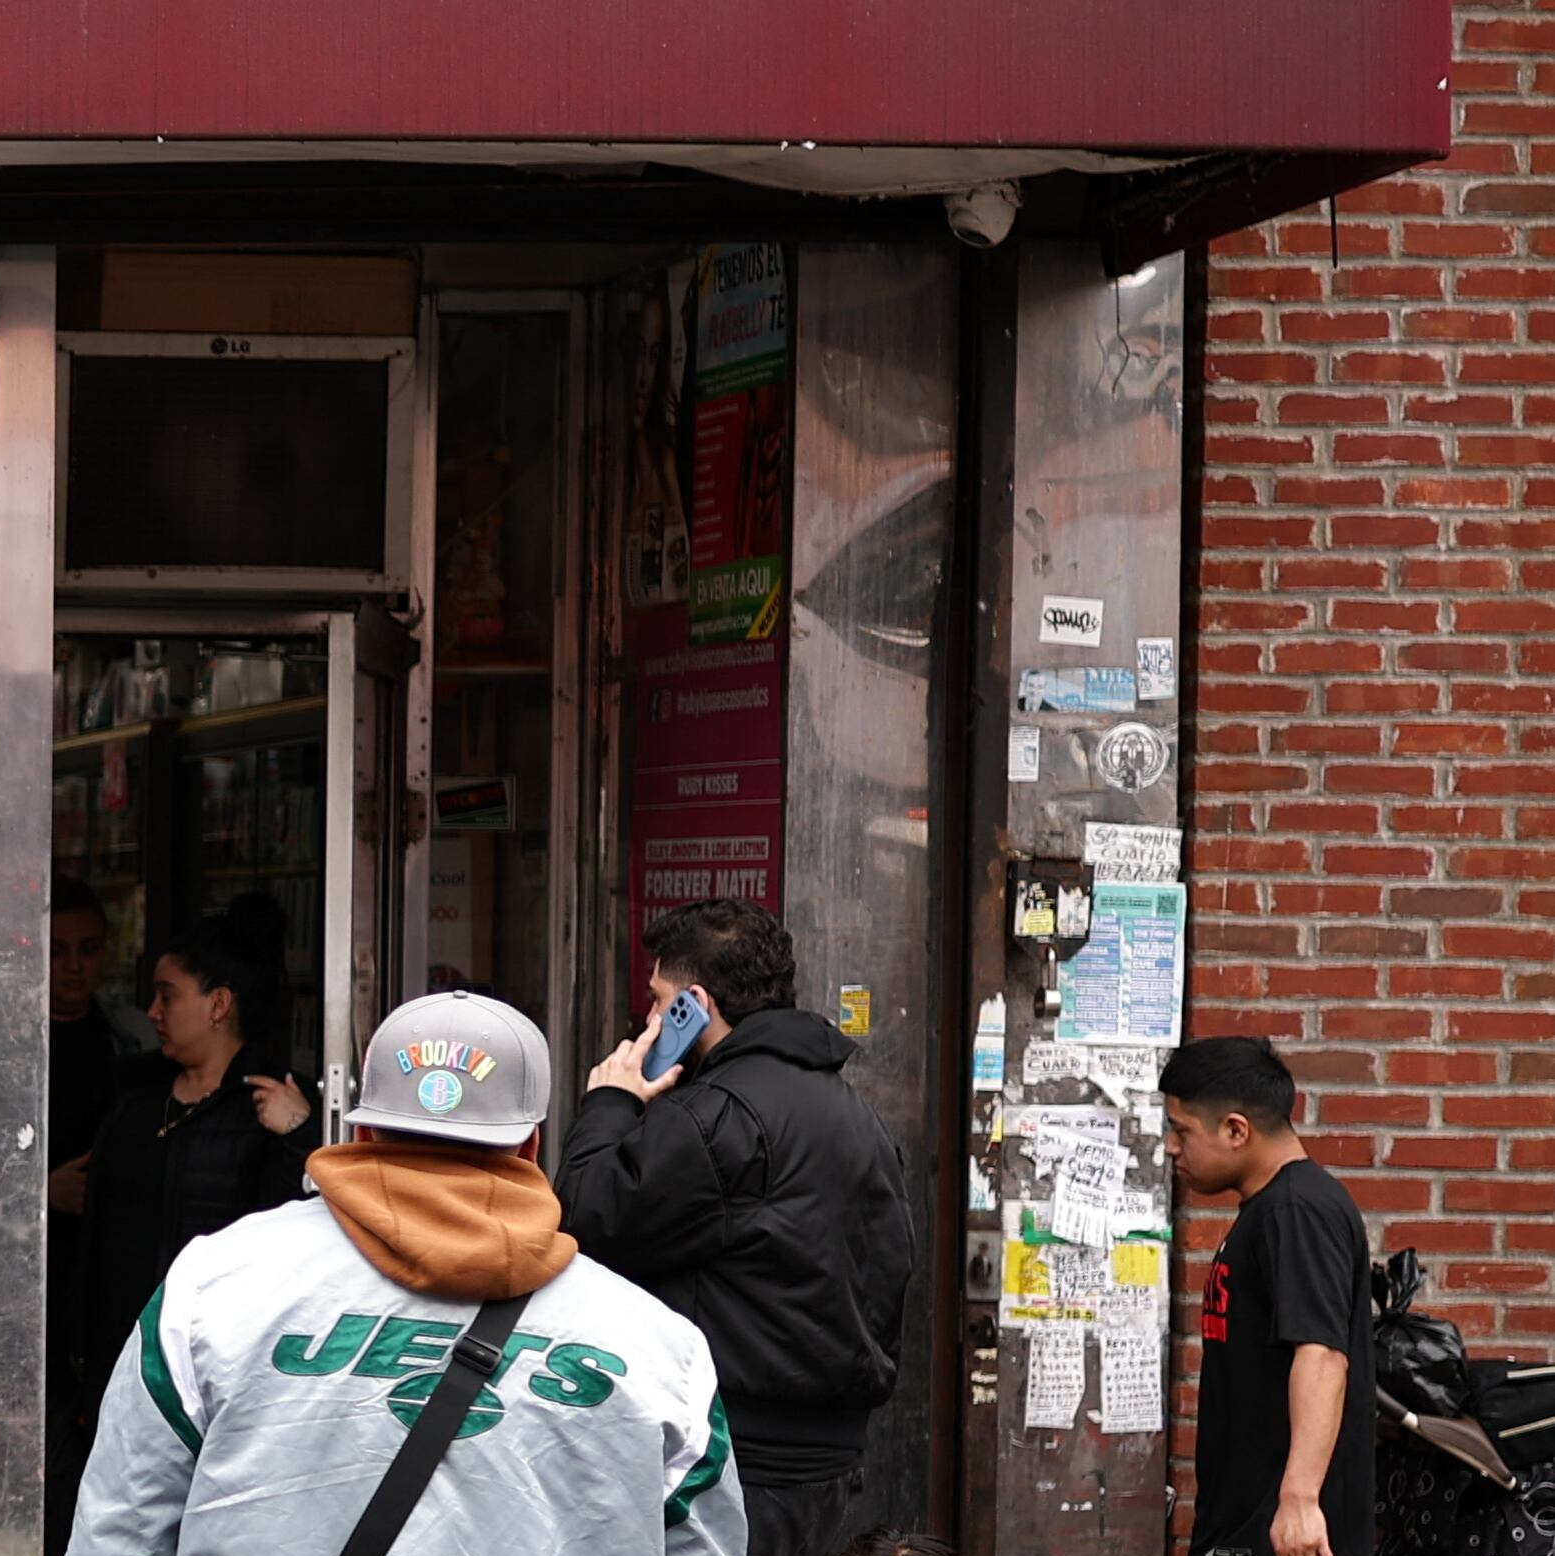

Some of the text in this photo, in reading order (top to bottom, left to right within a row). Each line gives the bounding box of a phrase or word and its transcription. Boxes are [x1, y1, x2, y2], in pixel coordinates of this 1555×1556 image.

[231, 341, 250, 353] LG
[644, 868, 768, 899] FOREVER MATTE
[396, 1039, 497, 1082] BROOKLYN
[271, 1313, 628, 1408] JETS
